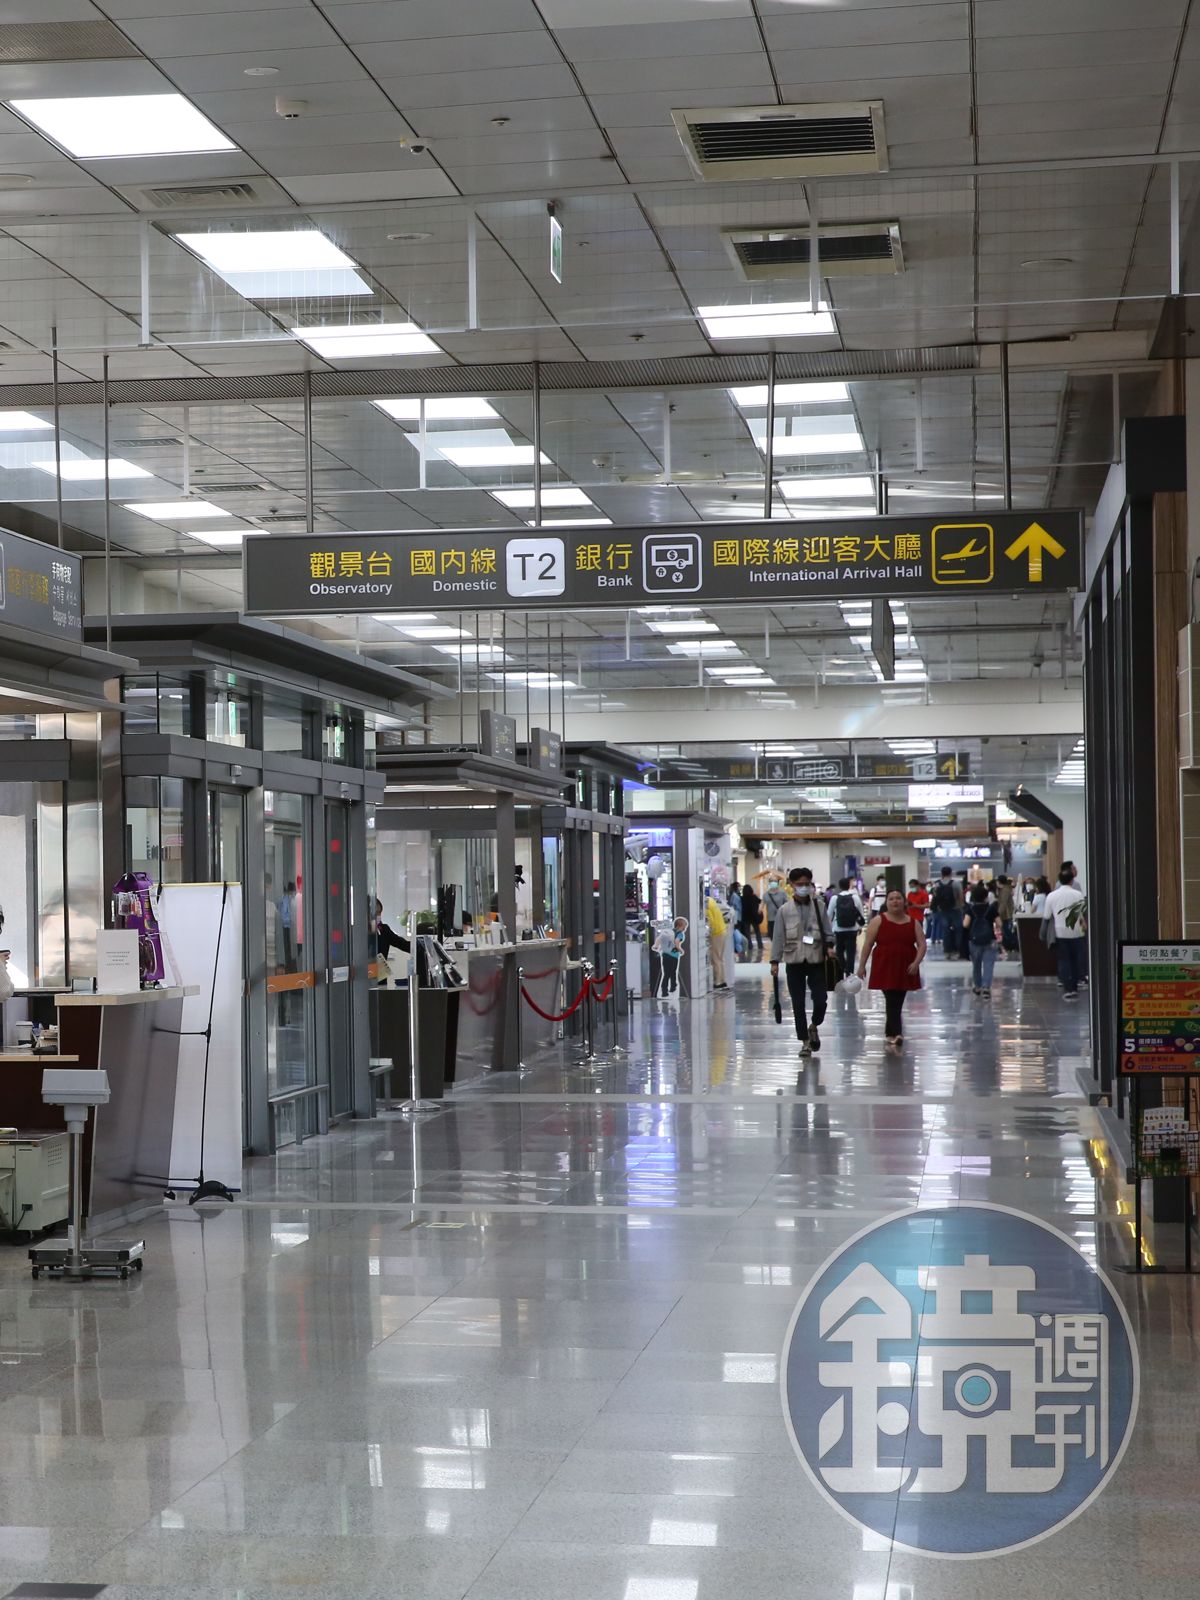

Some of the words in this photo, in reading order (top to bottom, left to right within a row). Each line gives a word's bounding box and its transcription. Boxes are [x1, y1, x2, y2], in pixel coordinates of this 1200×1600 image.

[309, 550, 393, 578] 觀景台
[410, 548, 497, 577] 國內線
[513, 553, 557, 581] T2
[575, 543, 633, 571] 銀行
[713, 533, 922, 567] 國際線迎客大廳
[309, 582, 393, 596] Observatory
[433, 578, 497, 592] Domestic
[597, 574, 633, 587] Bank
[749, 568, 839, 583] International
[843, 567, 890, 580] Arrival
[894, 565, 923, 578] Hall
[1126, 966, 1136, 980] 1
[1125, 984, 1136, 998] 2
[1125, 1002, 1136, 1016] 3
[1124, 1020, 1136, 1034] 4
[1124, 1038, 1136, 1053] 5
[1124, 1056, 1135, 1070] 6
